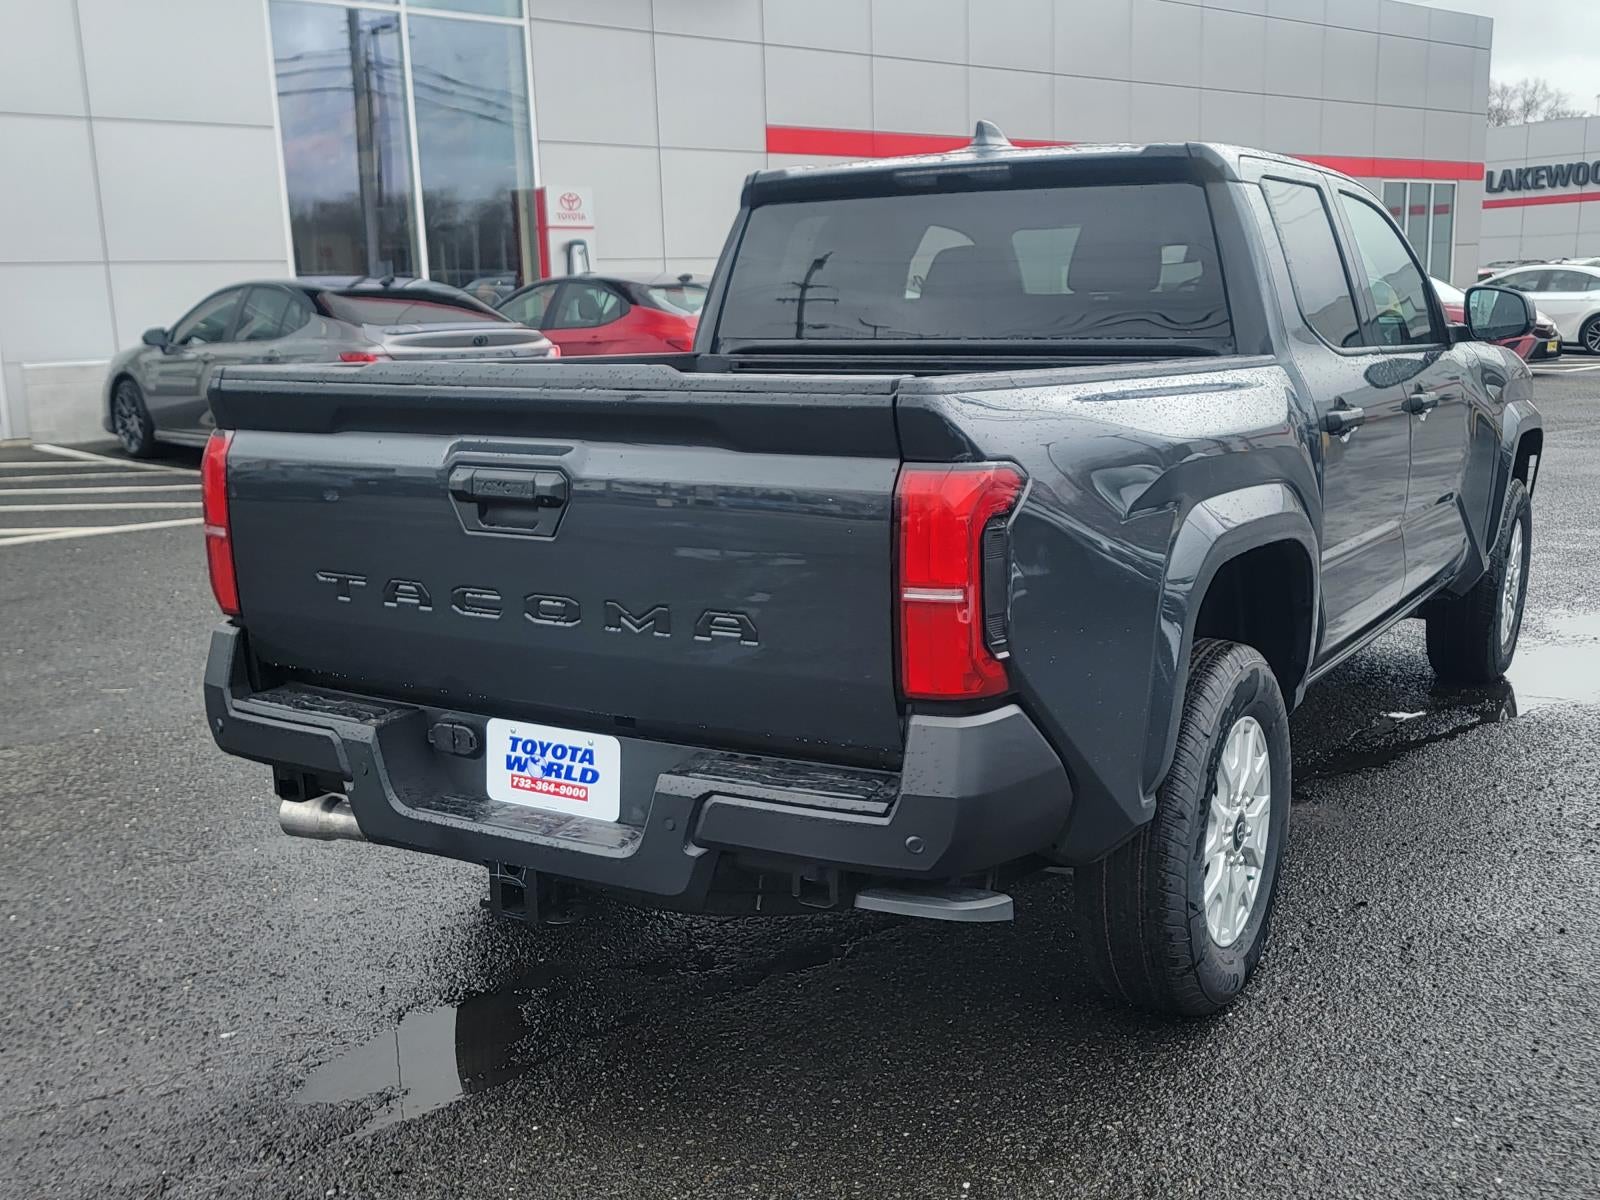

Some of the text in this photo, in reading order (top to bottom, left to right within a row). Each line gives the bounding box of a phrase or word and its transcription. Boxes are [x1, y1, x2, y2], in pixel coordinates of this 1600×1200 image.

[556, 211, 586, 221] TOYOTA
[315, 571, 759, 646] TACOMA
[509, 736, 595, 765] TOYOTA
[506, 754, 600, 784] WORLD
[512, 777, 587, 799] 732-364-9000
